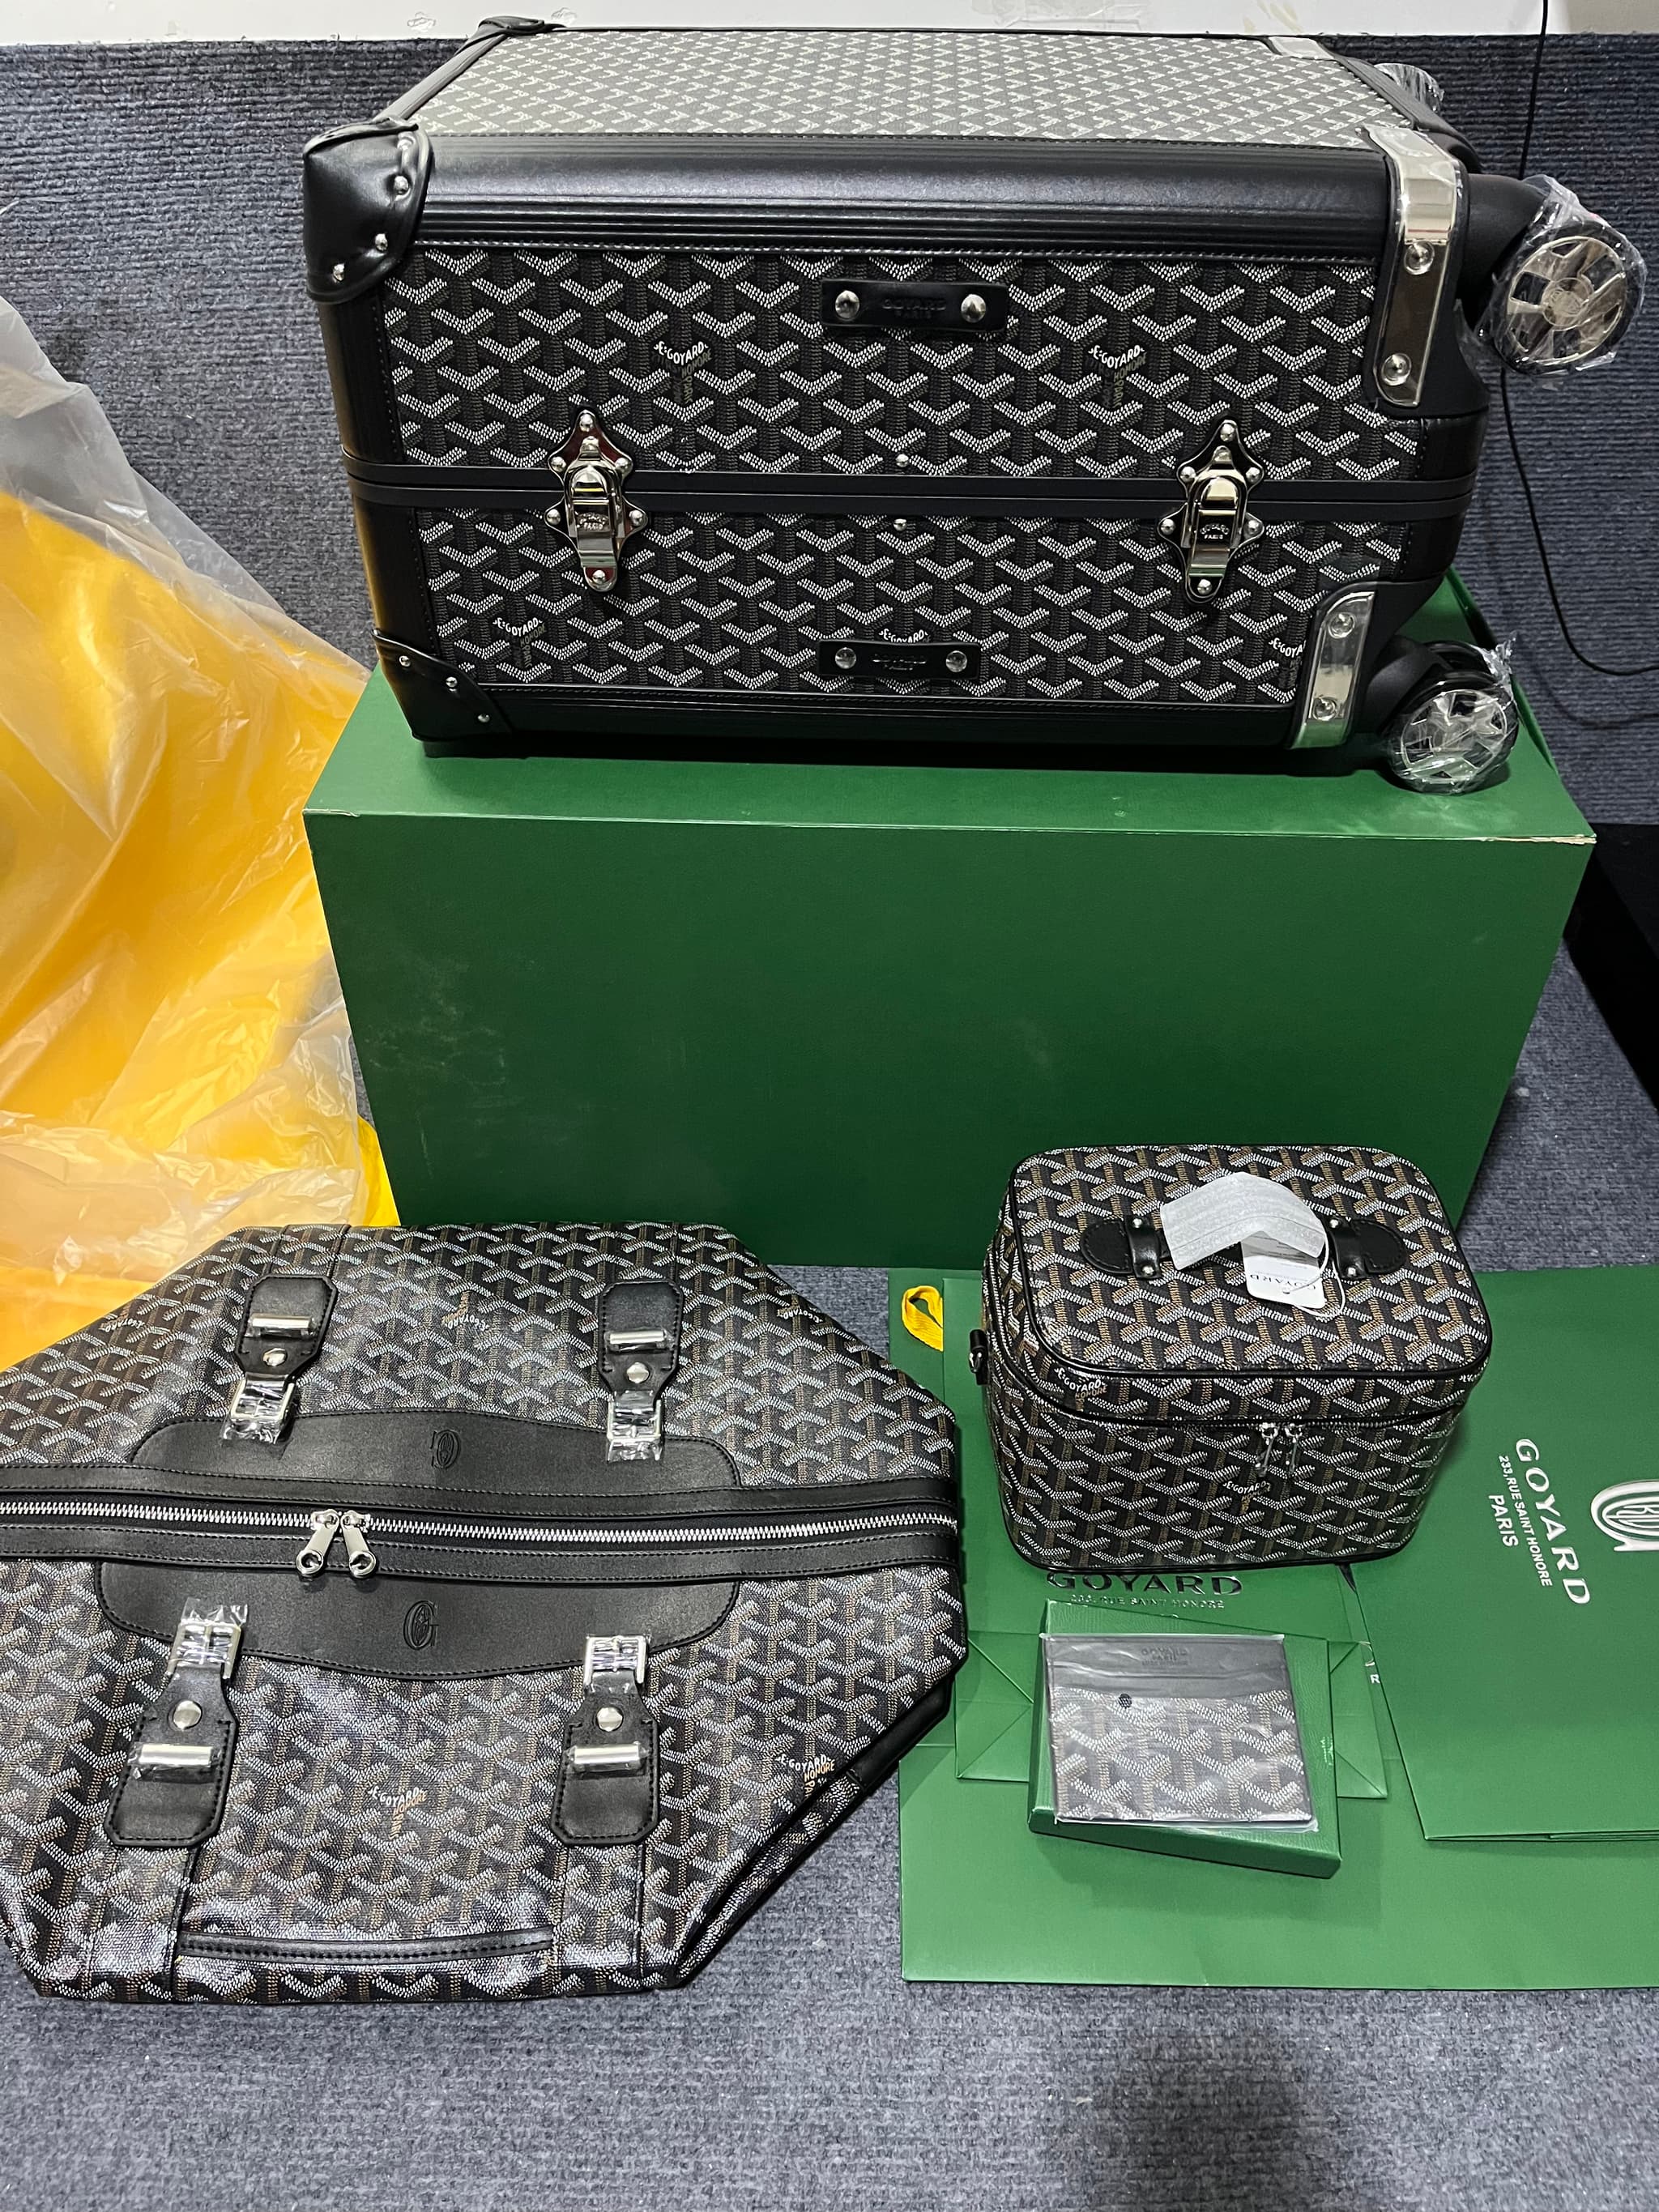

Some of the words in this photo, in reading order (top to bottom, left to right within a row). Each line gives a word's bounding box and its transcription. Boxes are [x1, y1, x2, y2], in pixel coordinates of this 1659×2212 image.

[1488, 1494, 1519, 1547] PARIS
[1514, 1500, 1537, 1536] SAINT
[1526, 1536, 1553, 1586] HONORE
[1516, 1438, 1591, 1604] GOYARD
[1047, 1571, 1243, 1595] GOYARD
[804, 1758, 835, 1782] HONORE
